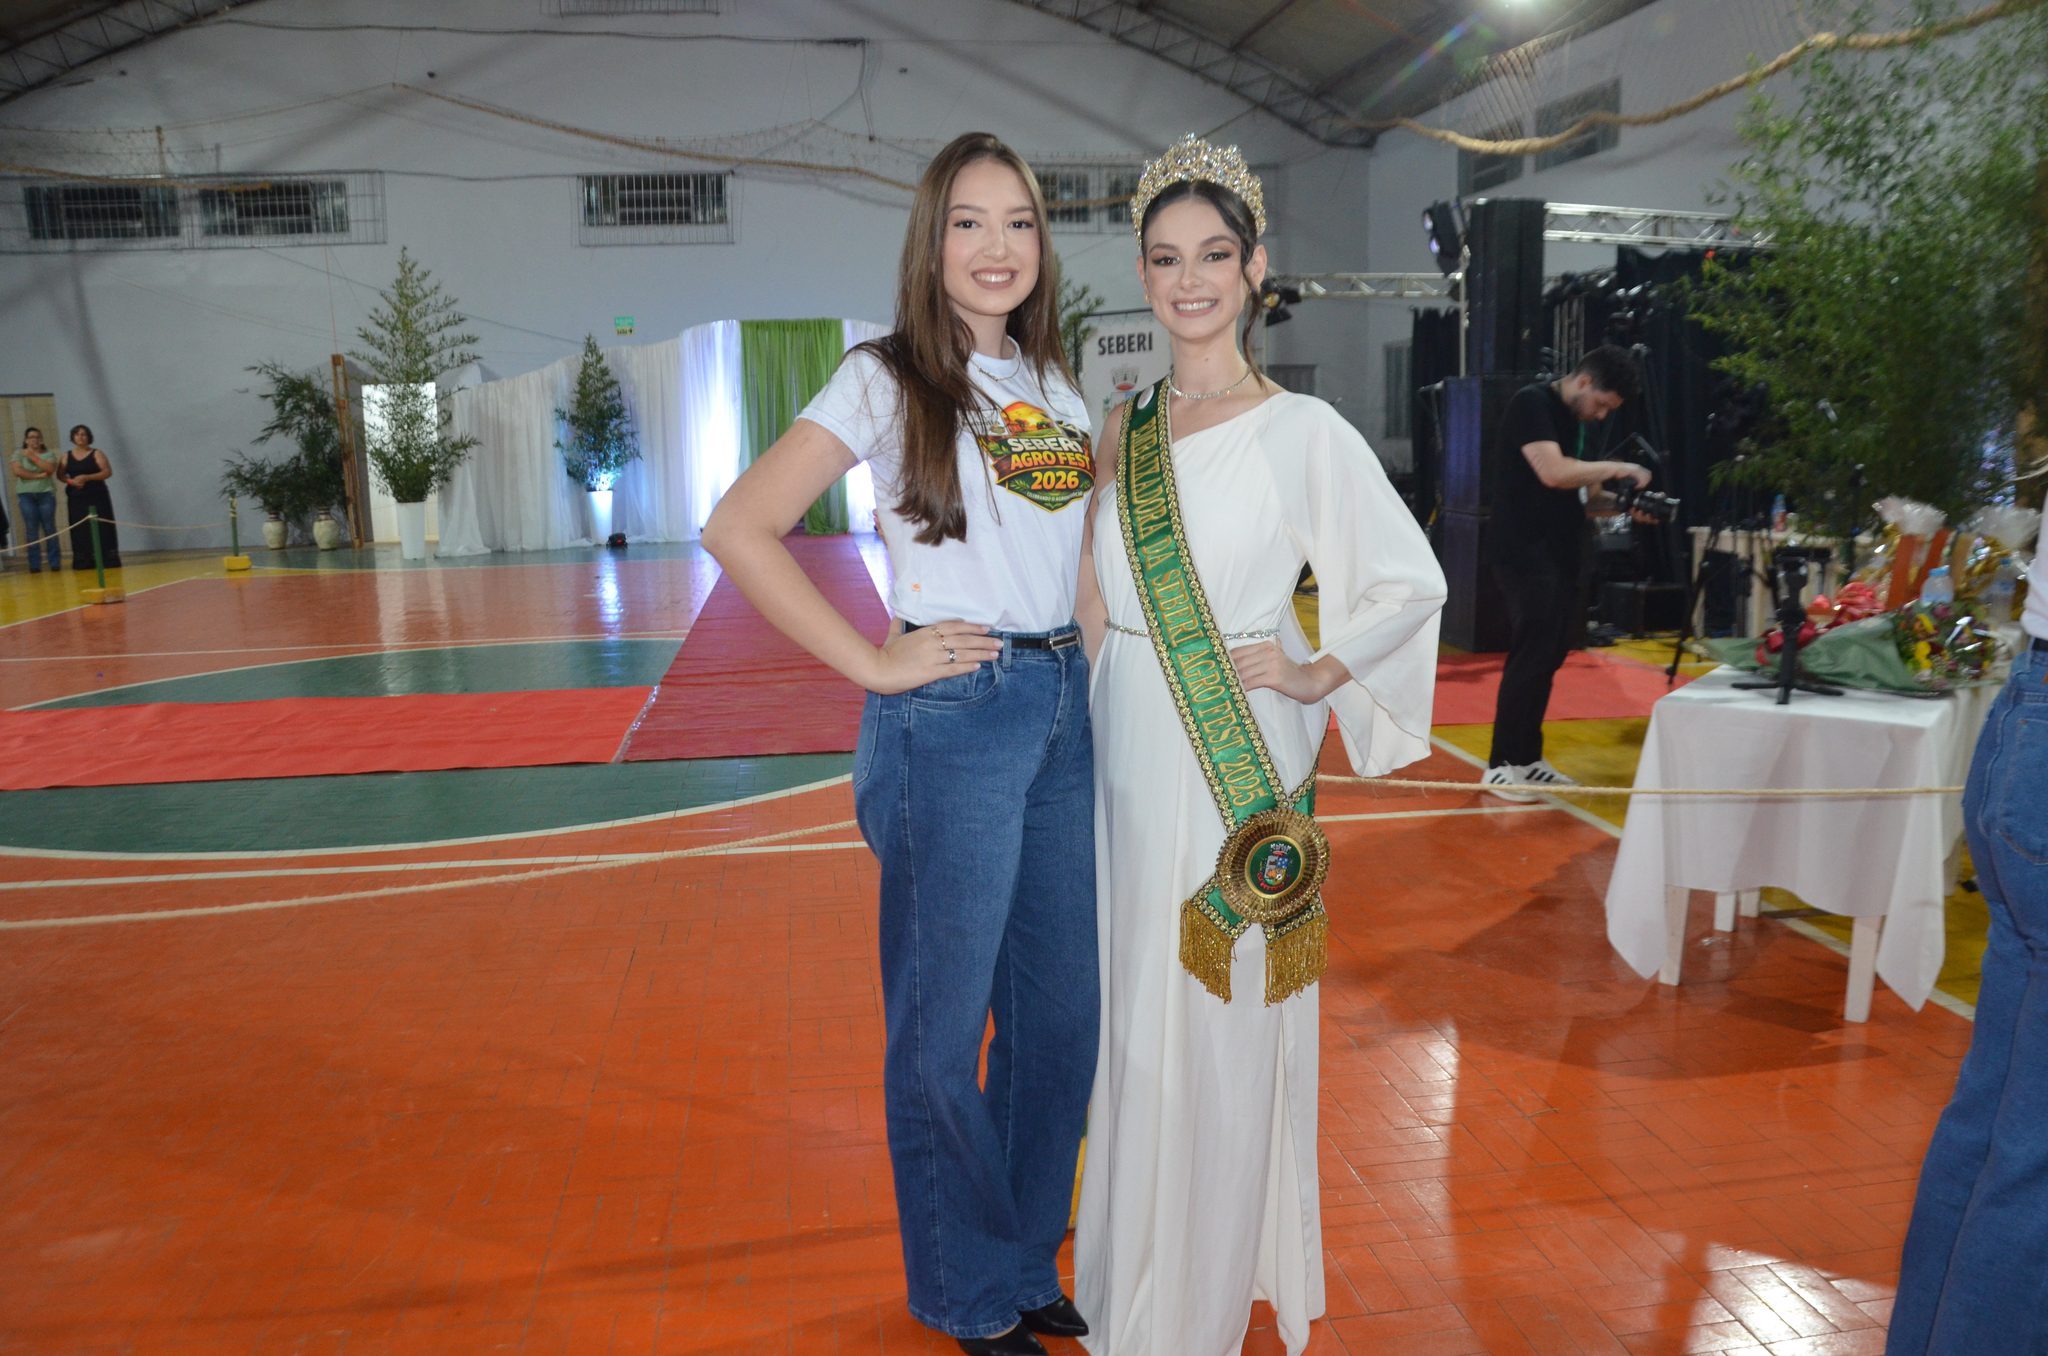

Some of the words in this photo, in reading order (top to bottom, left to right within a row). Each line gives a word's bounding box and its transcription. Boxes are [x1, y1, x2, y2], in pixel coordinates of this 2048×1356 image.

[1098, 331, 1153, 355] SEBERI
[1007, 437, 1083, 454] SEBERI
[1010, 450, 1057, 470] AGRO
[1056, 451, 1090, 470] FEST
[1030, 470, 1080, 491] 2026
[1142, 534, 1175, 570] DA
[1152, 569, 1204, 648] SEBERI
[1176, 648, 1226, 704] AGRO
[1197, 700, 1246, 754] FEST
[1218, 753, 1269, 807] 2025
